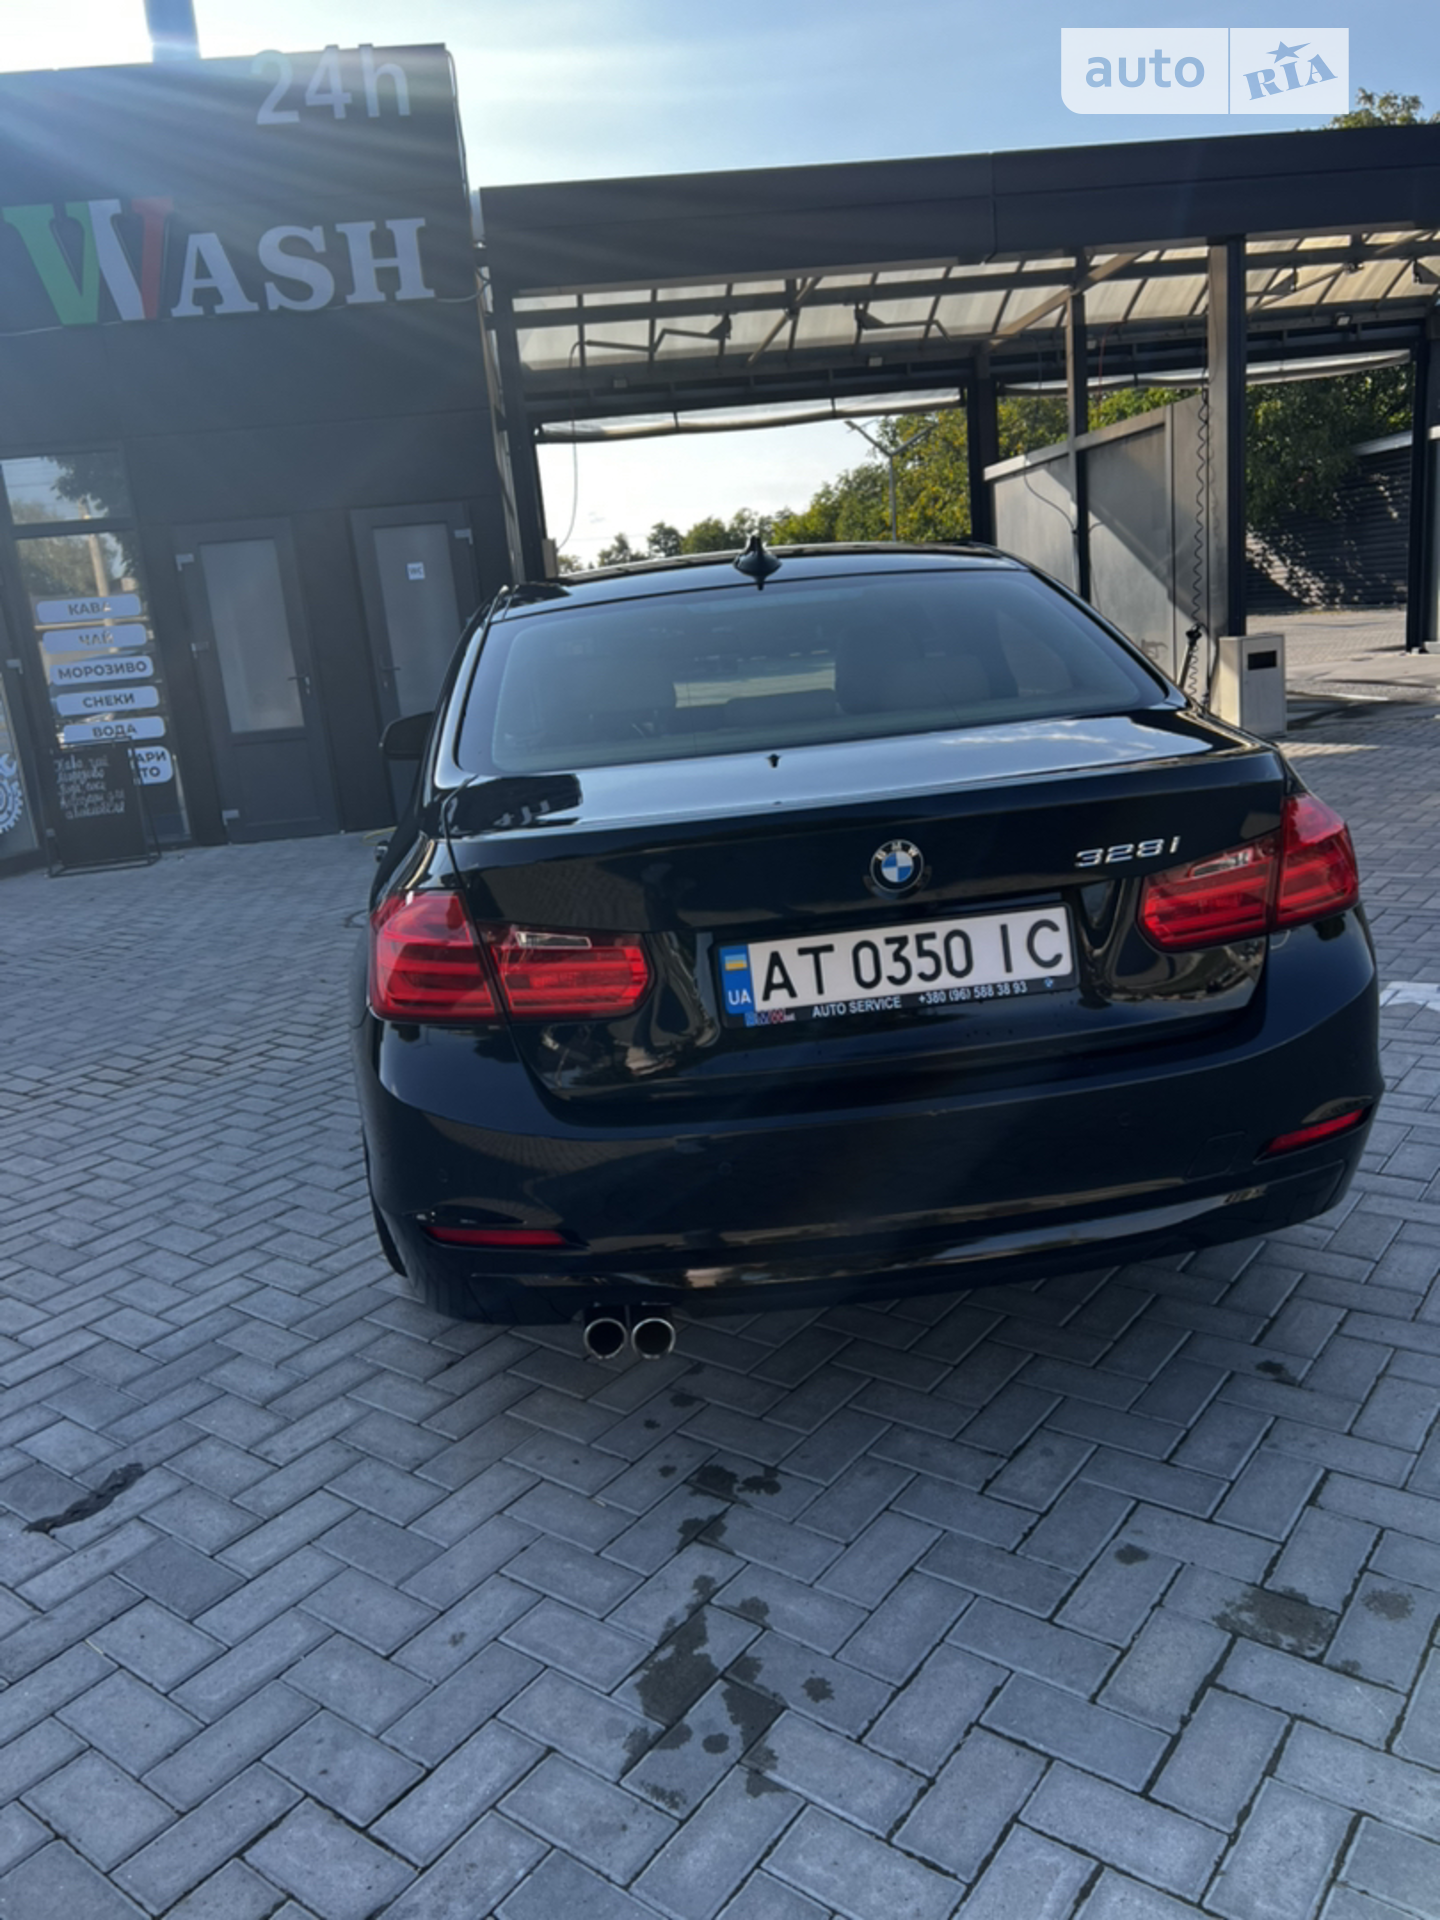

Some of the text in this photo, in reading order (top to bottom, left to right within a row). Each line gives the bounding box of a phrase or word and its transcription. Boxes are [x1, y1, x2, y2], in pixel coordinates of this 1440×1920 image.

[250, 42, 412, 125] 24h
[3, 198, 436, 326] WASH
[68, 601, 112, 616] КАВА
[78, 629, 114, 646] ЧАЙ
[57, 660, 147, 680] МОРОЗИВО
[82, 693, 136, 709] СНЕКИ
[92, 723, 138, 738] ВОДА
[136, 751, 167, 763] АРИ
[139, 766, 161, 777] ТО
[761, 918, 1063, 1002] AT 0350 IC
[728, 988, 751, 1006] UA
[812, 1001, 847, 1018] AUTO
[849, 996, 902, 1014] SERVICE
[918, 991, 947, 1005] +380
[949, 988, 971, 1002] (96)
[974, 985, 994, 999] 588
[996, 983, 1011, 996] 38
[1012, 980, 1028, 994] 93
